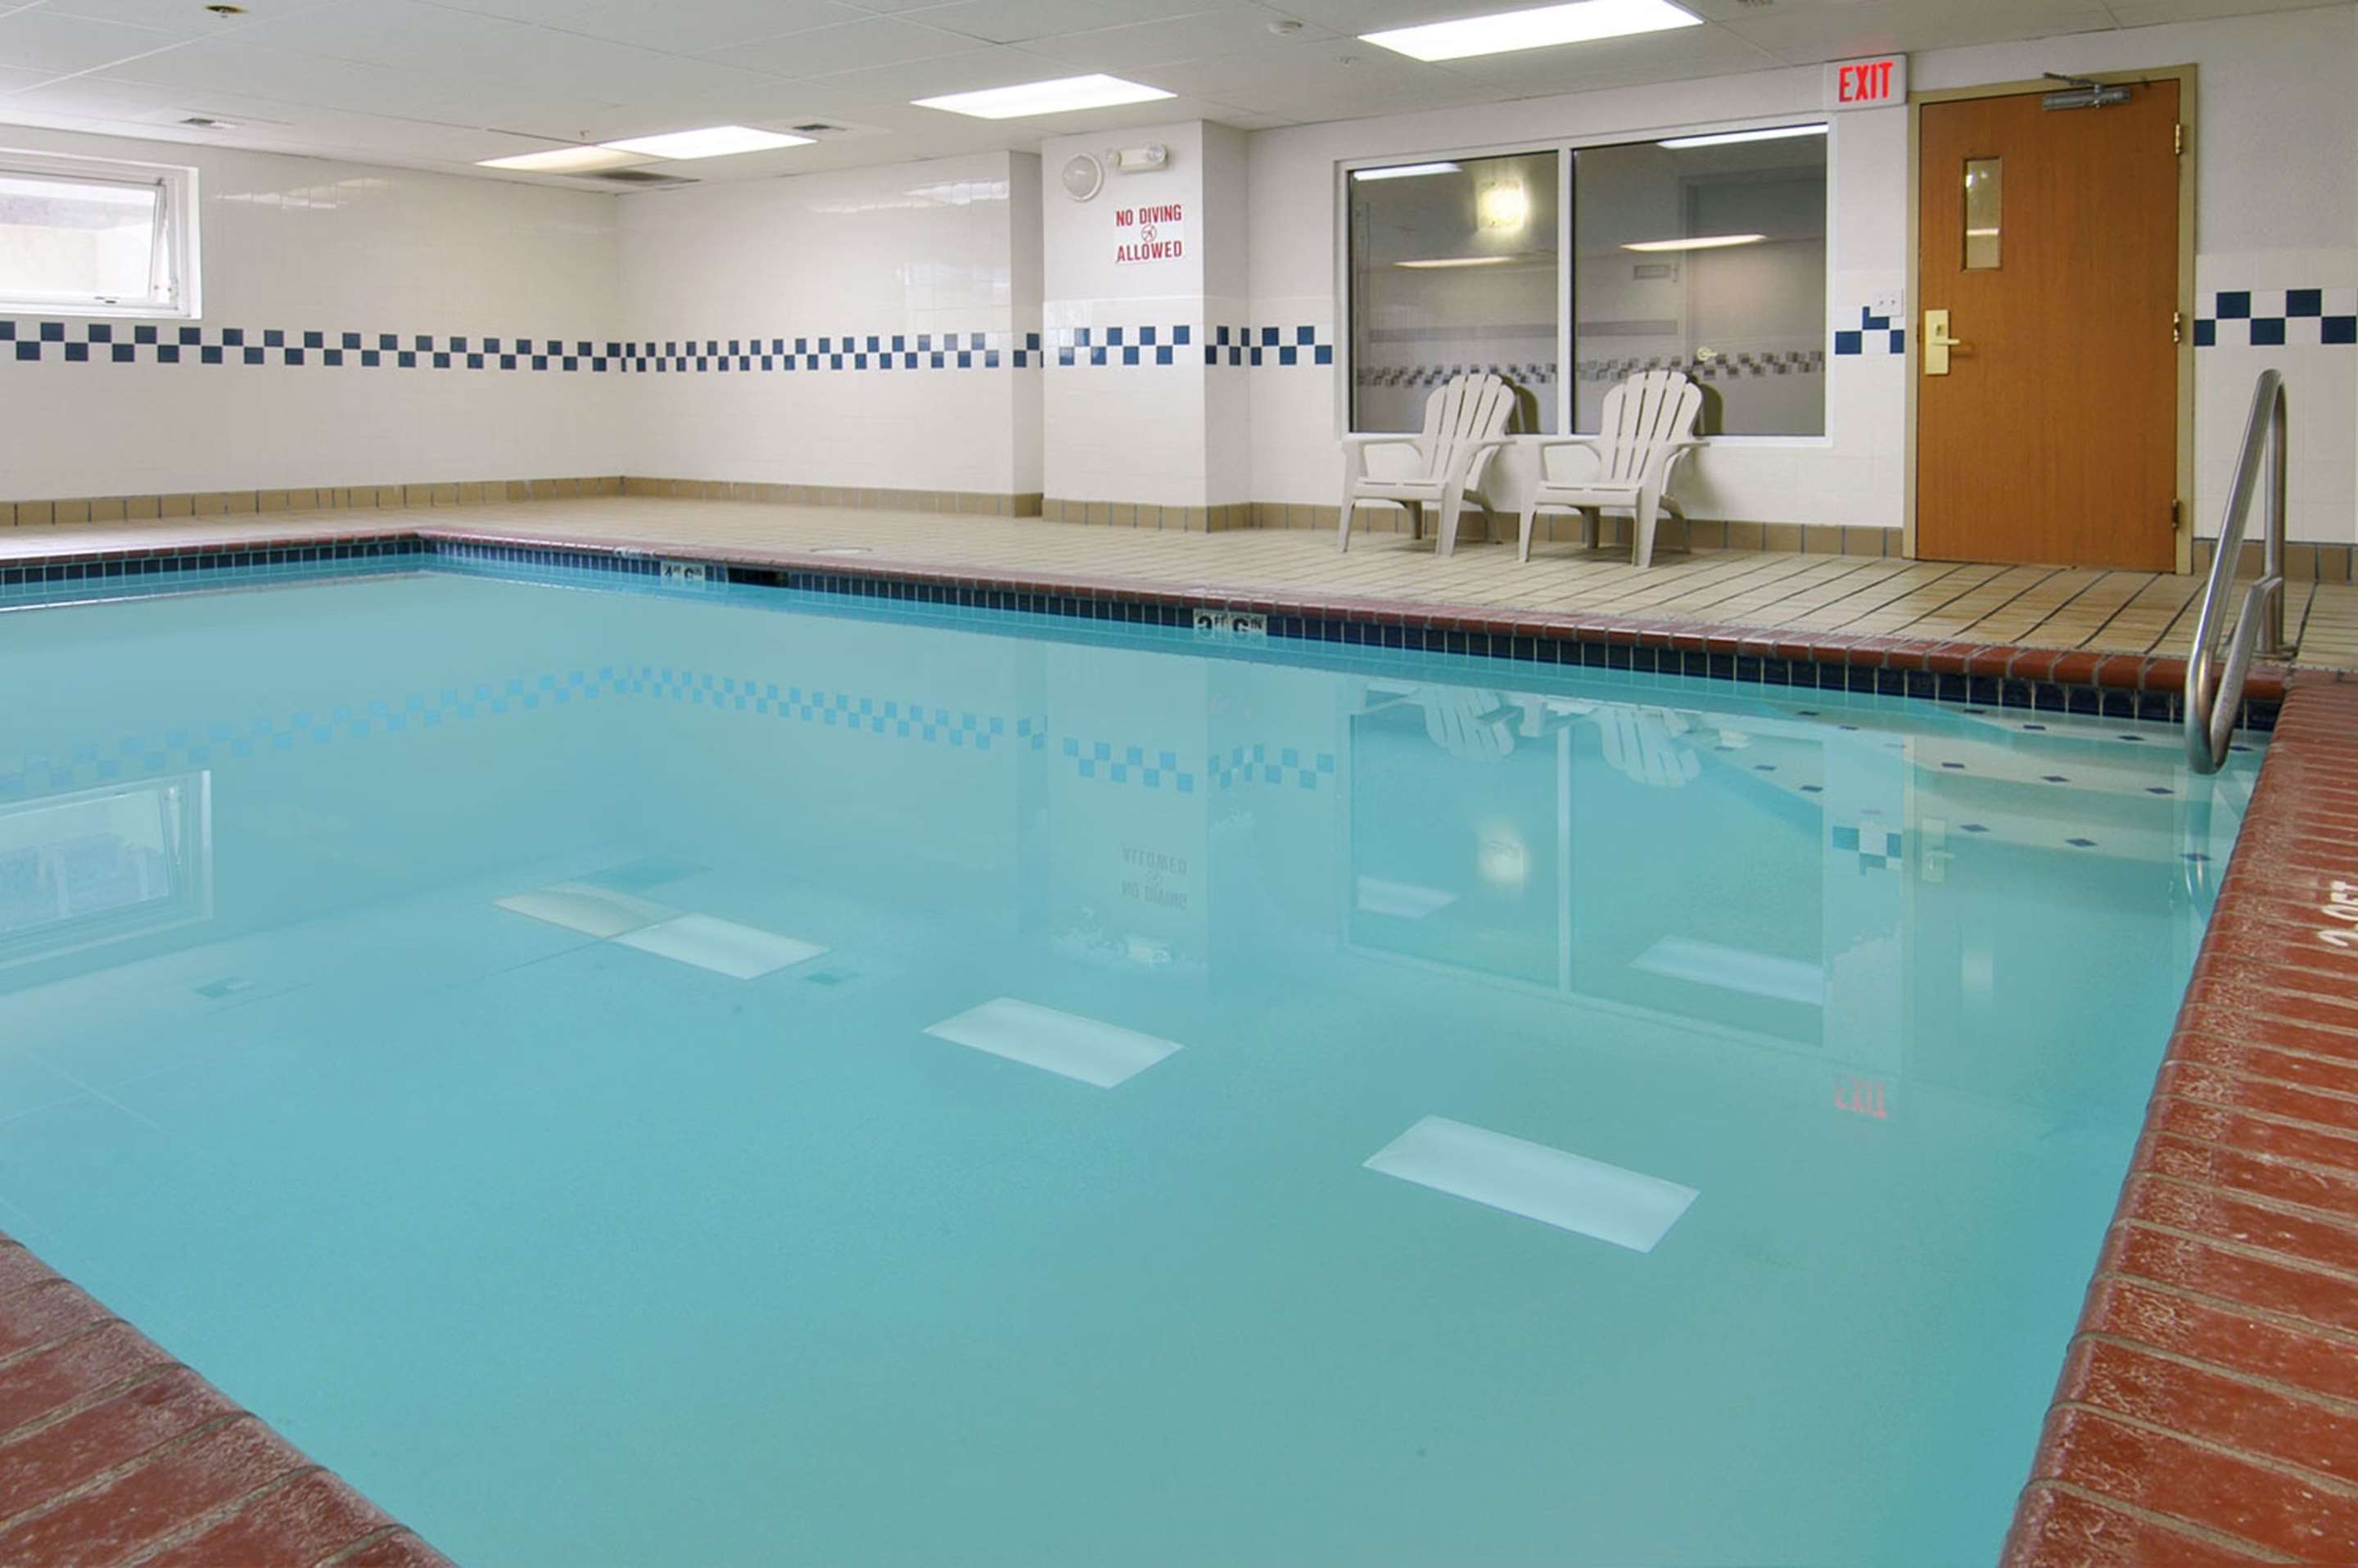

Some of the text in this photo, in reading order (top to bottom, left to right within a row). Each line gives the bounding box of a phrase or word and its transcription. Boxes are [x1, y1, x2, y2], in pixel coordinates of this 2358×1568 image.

[1838, 61, 1894, 103] EXIT
[1116, 205, 1182, 227] NO DIVING
[1117, 241, 1182, 262] ALLOWED
